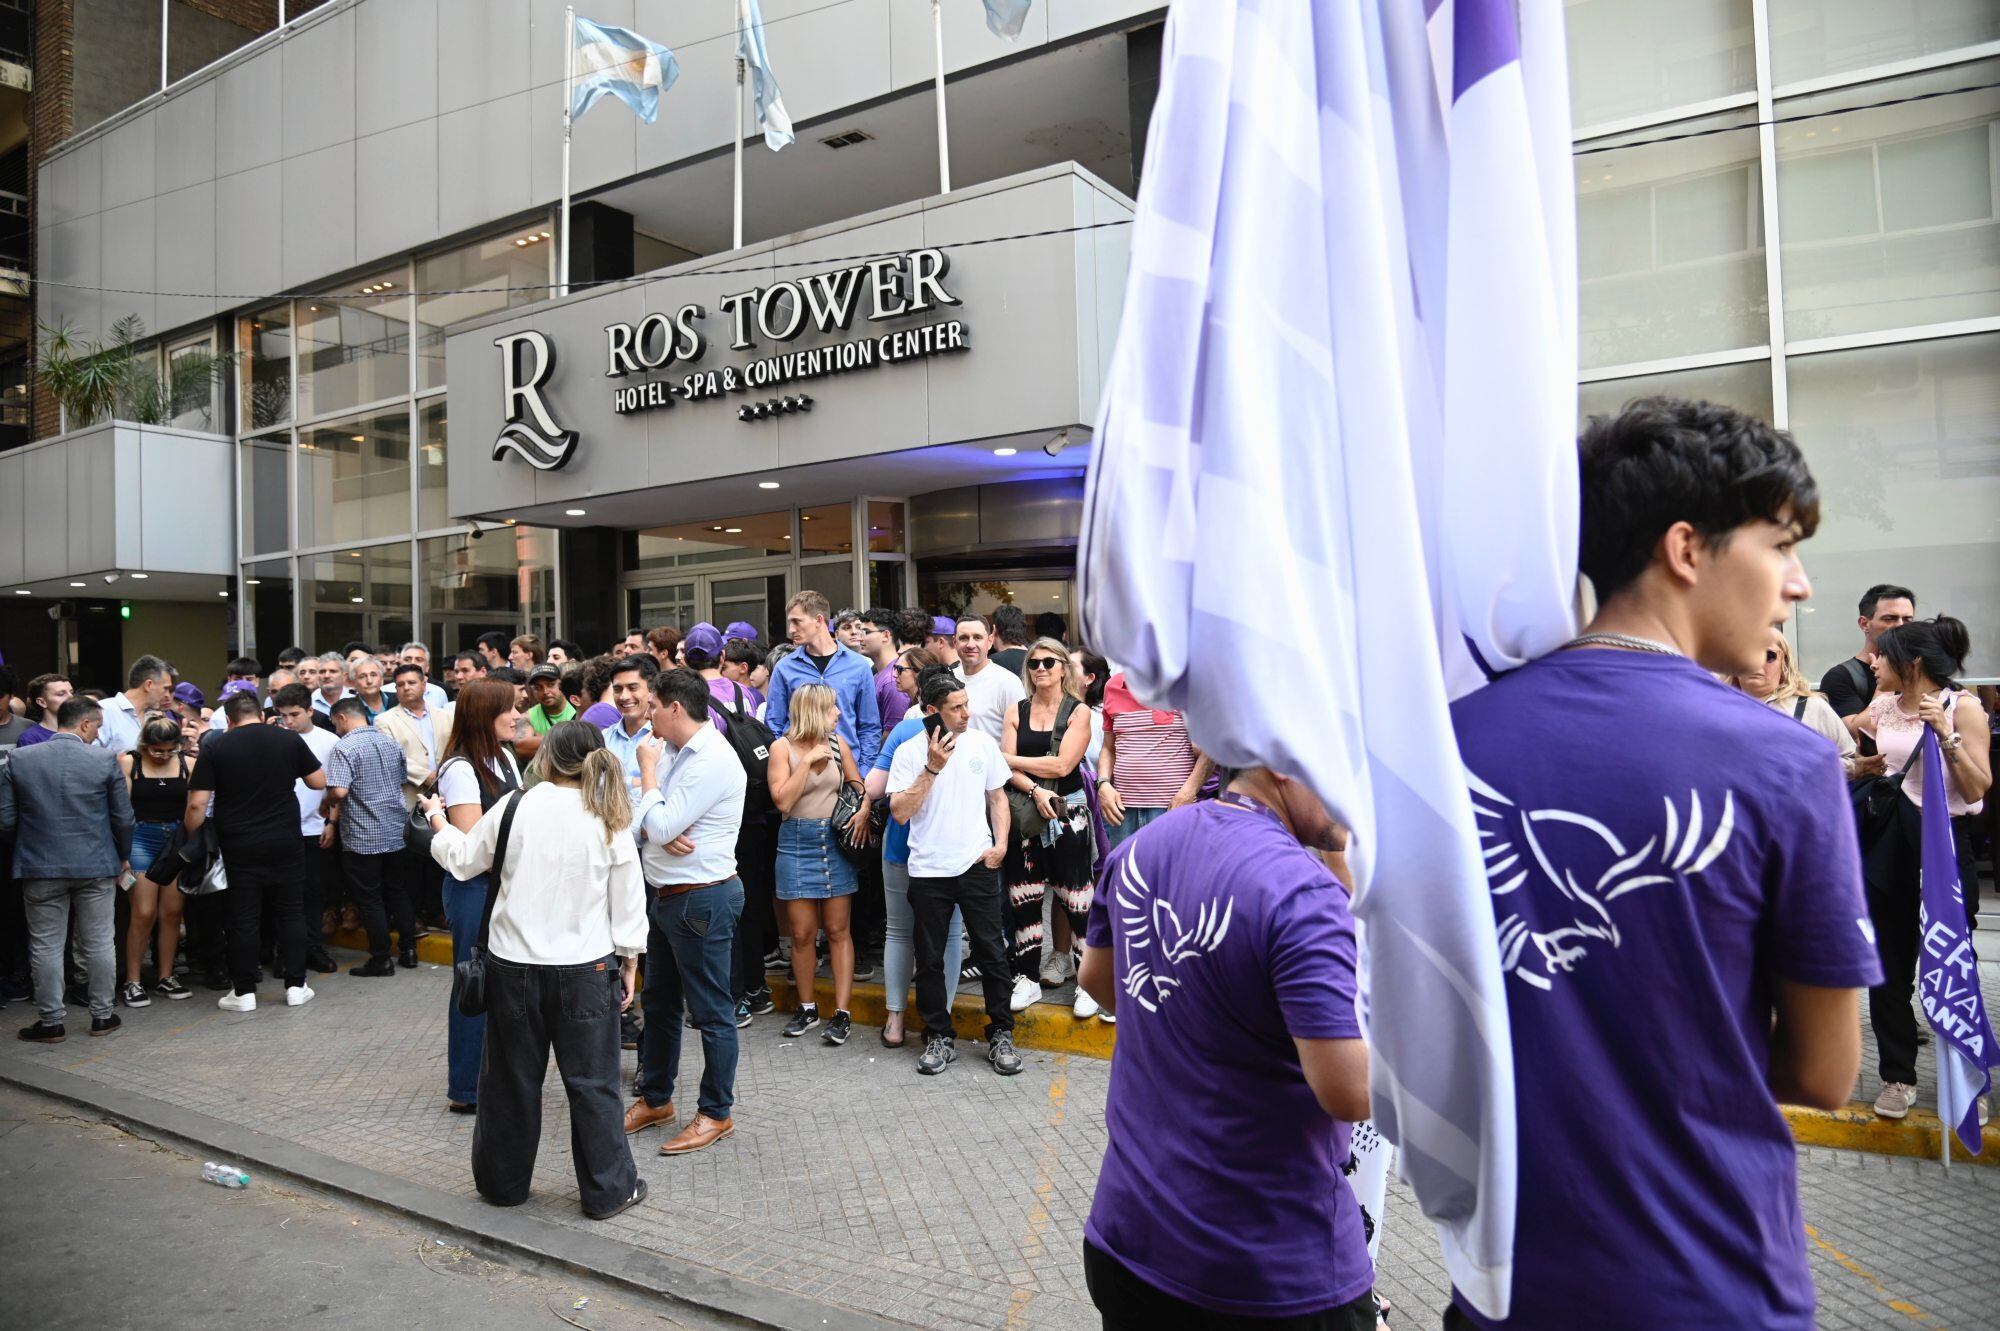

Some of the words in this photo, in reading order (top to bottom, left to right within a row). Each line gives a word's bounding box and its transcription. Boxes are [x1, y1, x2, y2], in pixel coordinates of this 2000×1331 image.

[604, 304, 702, 377] ROS
[719, 248, 958, 350] TOWER
[494, 329, 565, 437] R
[615, 382, 667, 413] HOTEL
[683, 371, 719, 400] SPA
[723, 366, 737, 391] &
[744, 339, 872, 387] CONVENTION
[879, 321, 963, 361] CENTER
[1924, 968, 1980, 1023] AVA
[1352, 1127, 1379, 1148] LIBE
